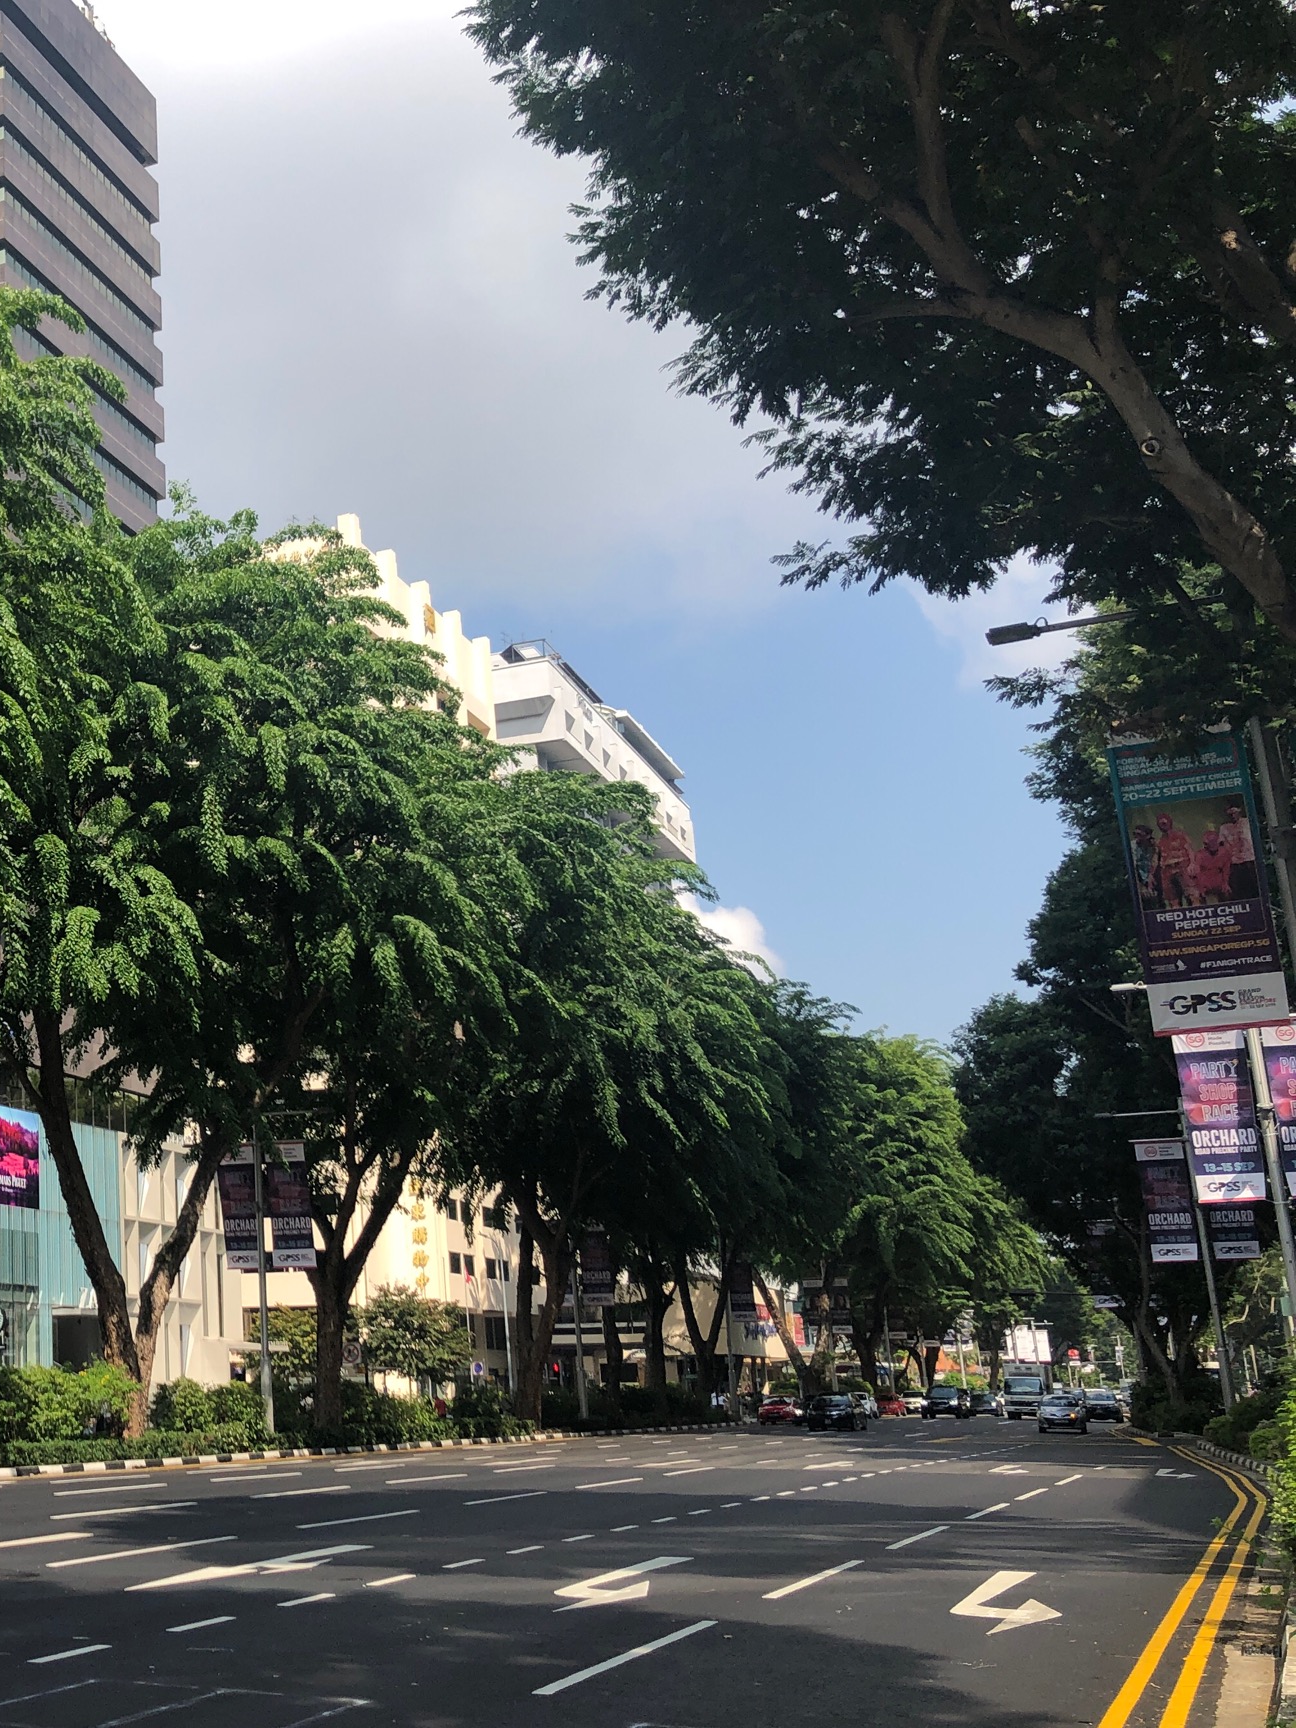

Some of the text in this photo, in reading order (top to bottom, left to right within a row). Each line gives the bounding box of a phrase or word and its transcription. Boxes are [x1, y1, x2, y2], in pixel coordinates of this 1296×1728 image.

[1210, 756, 1233, 766] PRIX
[1121, 770, 1240, 792] MARINA BAY STREET CIRCUIT
[1164, 778, 1243, 796] SEPTEMBER
[1157, 904, 1250, 922] RED HOT CHILI
[1175, 916, 1234, 930] PEPPERS
[1172, 929, 1208, 939] SUNDAY
[1224, 925, 1241, 933] SEP
[1149, 938, 1270, 957] WWW.SINGAPOREGP.SG
[1200, 955, 1272, 968] #F1NIGHTRACE
[1168, 991, 1237, 1015] GPSS
[1190, 1059, 1238, 1079] PARTY
[1199, 1083, 1237, 1101] SHOP
[1202, 1103, 1240, 1122] RACE
[1192, 1128, 1256, 1147] ORCHARD
[1235, 1162, 1255, 1171] SEP
[1208, 1181, 1240, 1193] GPSS
[1148, 1213, 1192, 1225] ORCHARD
[1210, 1210, 1254, 1222] ORCHARD
[225, 1219, 257, 1231] ORCHAR
[273, 1217, 310, 1230] ORCHARD
[1158, 1248, 1182, 1256] GPSS
[1220, 1246, 1243, 1254] GPSS
[231, 1255, 250, 1263] GPSS
[279, 1254, 300, 1262] GPSS
